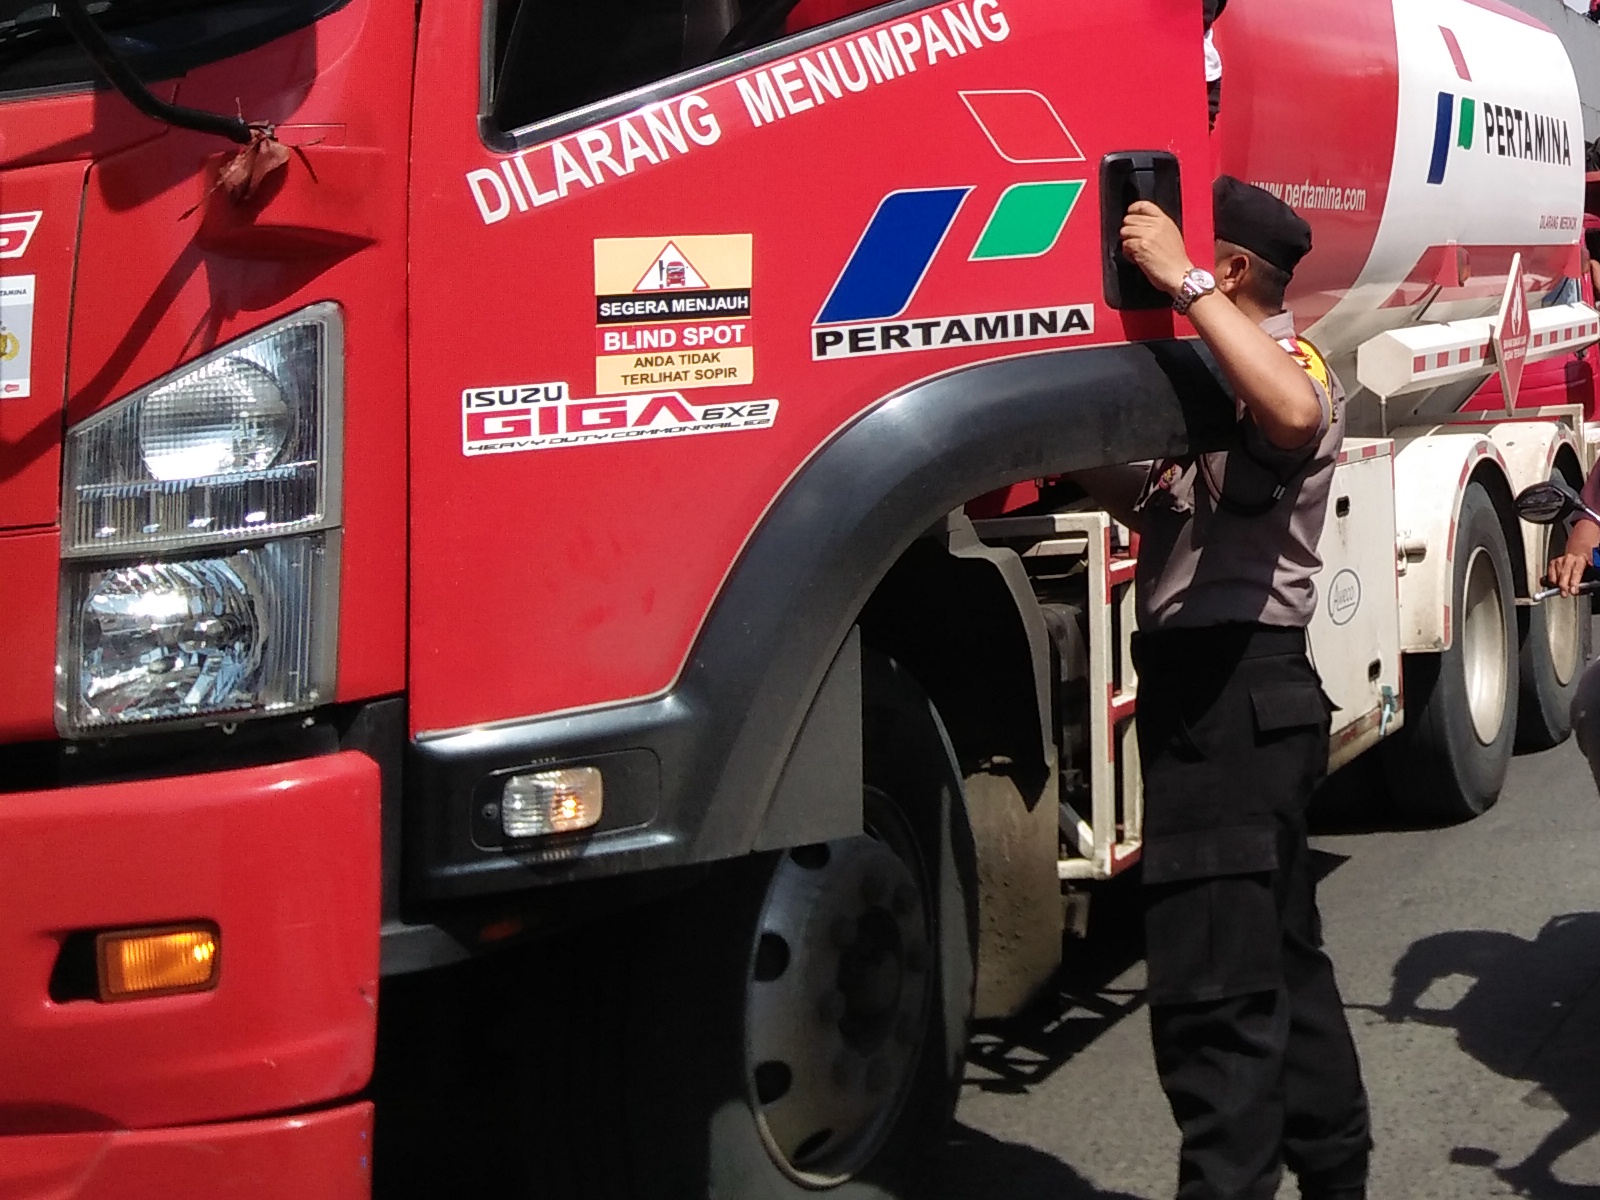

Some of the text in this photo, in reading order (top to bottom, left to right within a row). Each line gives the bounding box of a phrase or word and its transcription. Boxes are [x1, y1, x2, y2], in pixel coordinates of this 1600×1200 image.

[1483, 101, 1572, 167] PERTAMINA
[466, 95, 722, 225] DILARANG
[599, 295, 749, 317] SEGERA MENJAUH
[603, 323, 746, 352] BLIND SPOT
[815, 307, 1091, 357] PERTAMINA
[633, 351, 721, 369] ANDA TIDAK
[620, 366, 738, 386] TERLIHAT SOPIR
[465, 384, 563, 409] ISUZU
[466, 394, 770, 443] GIGA 6X2
[466, 439, 547, 451] HEAVY
[548, 434, 610, 445] DUTY
[610, 420, 742, 439] COMMONRAIL
